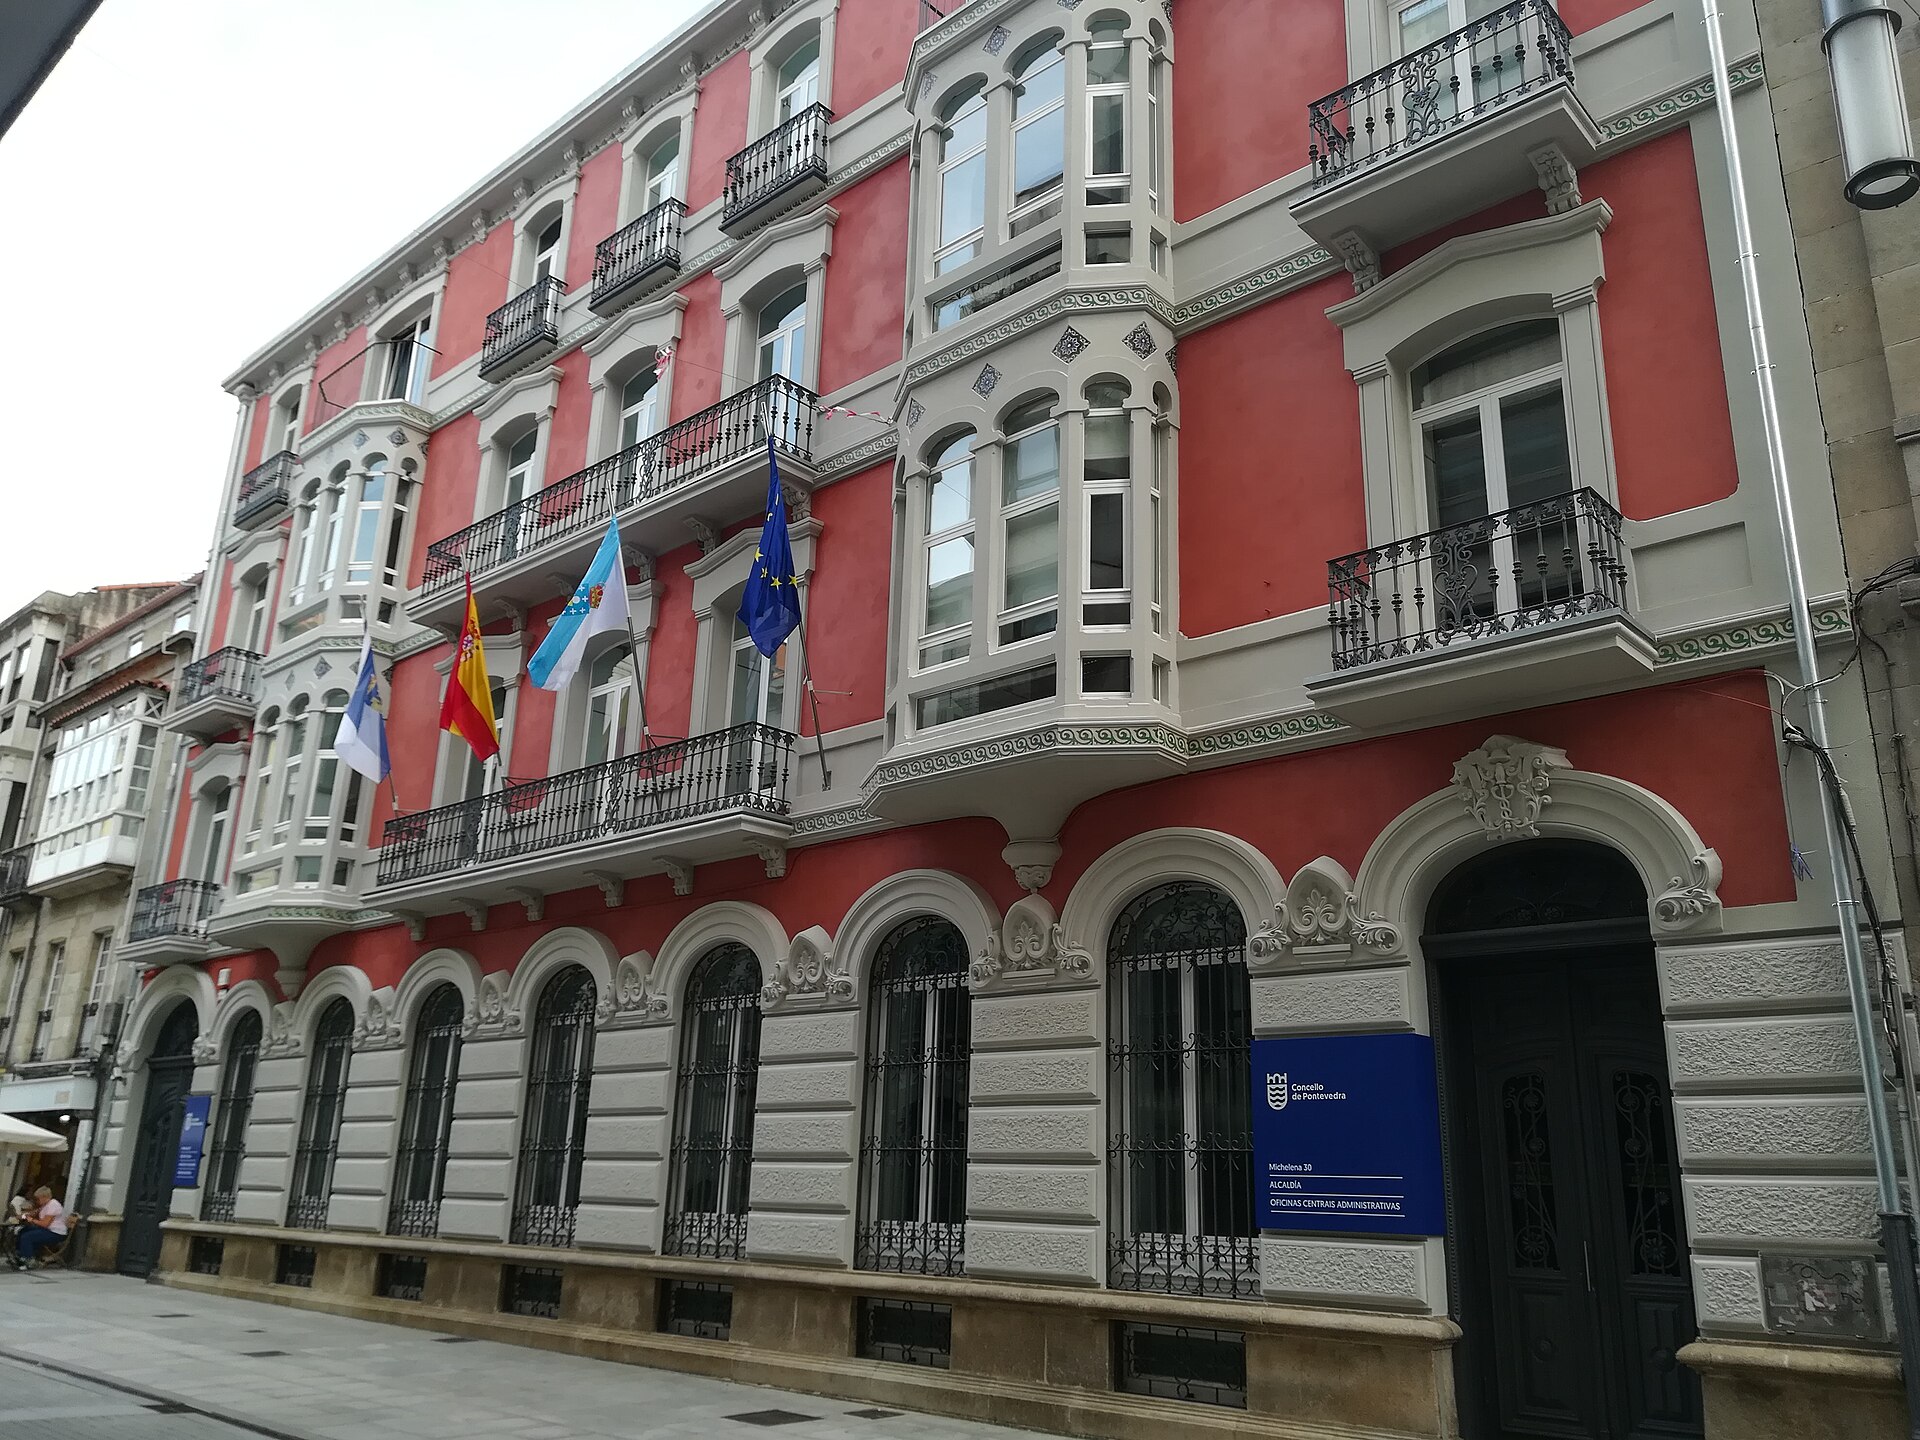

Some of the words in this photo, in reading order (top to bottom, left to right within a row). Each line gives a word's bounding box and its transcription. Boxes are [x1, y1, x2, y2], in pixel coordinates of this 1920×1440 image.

[1291, 1083, 1324, 1091] Concello
[1291, 1092, 1302, 1100] de
[1302, 1091, 1346, 1100] Pontevedra
[1269, 1163, 1303, 1171] Michelena
[1303, 1163, 1313, 1171] 30
[1269, 1179, 1302, 1189] ALCALDÍA
[1270, 1198, 1302, 1207] OFICINAS
[1302, 1199, 1336, 1208] CENTRAIS
[1336, 1200, 1401, 1211] ADMINISTRATIVAS
